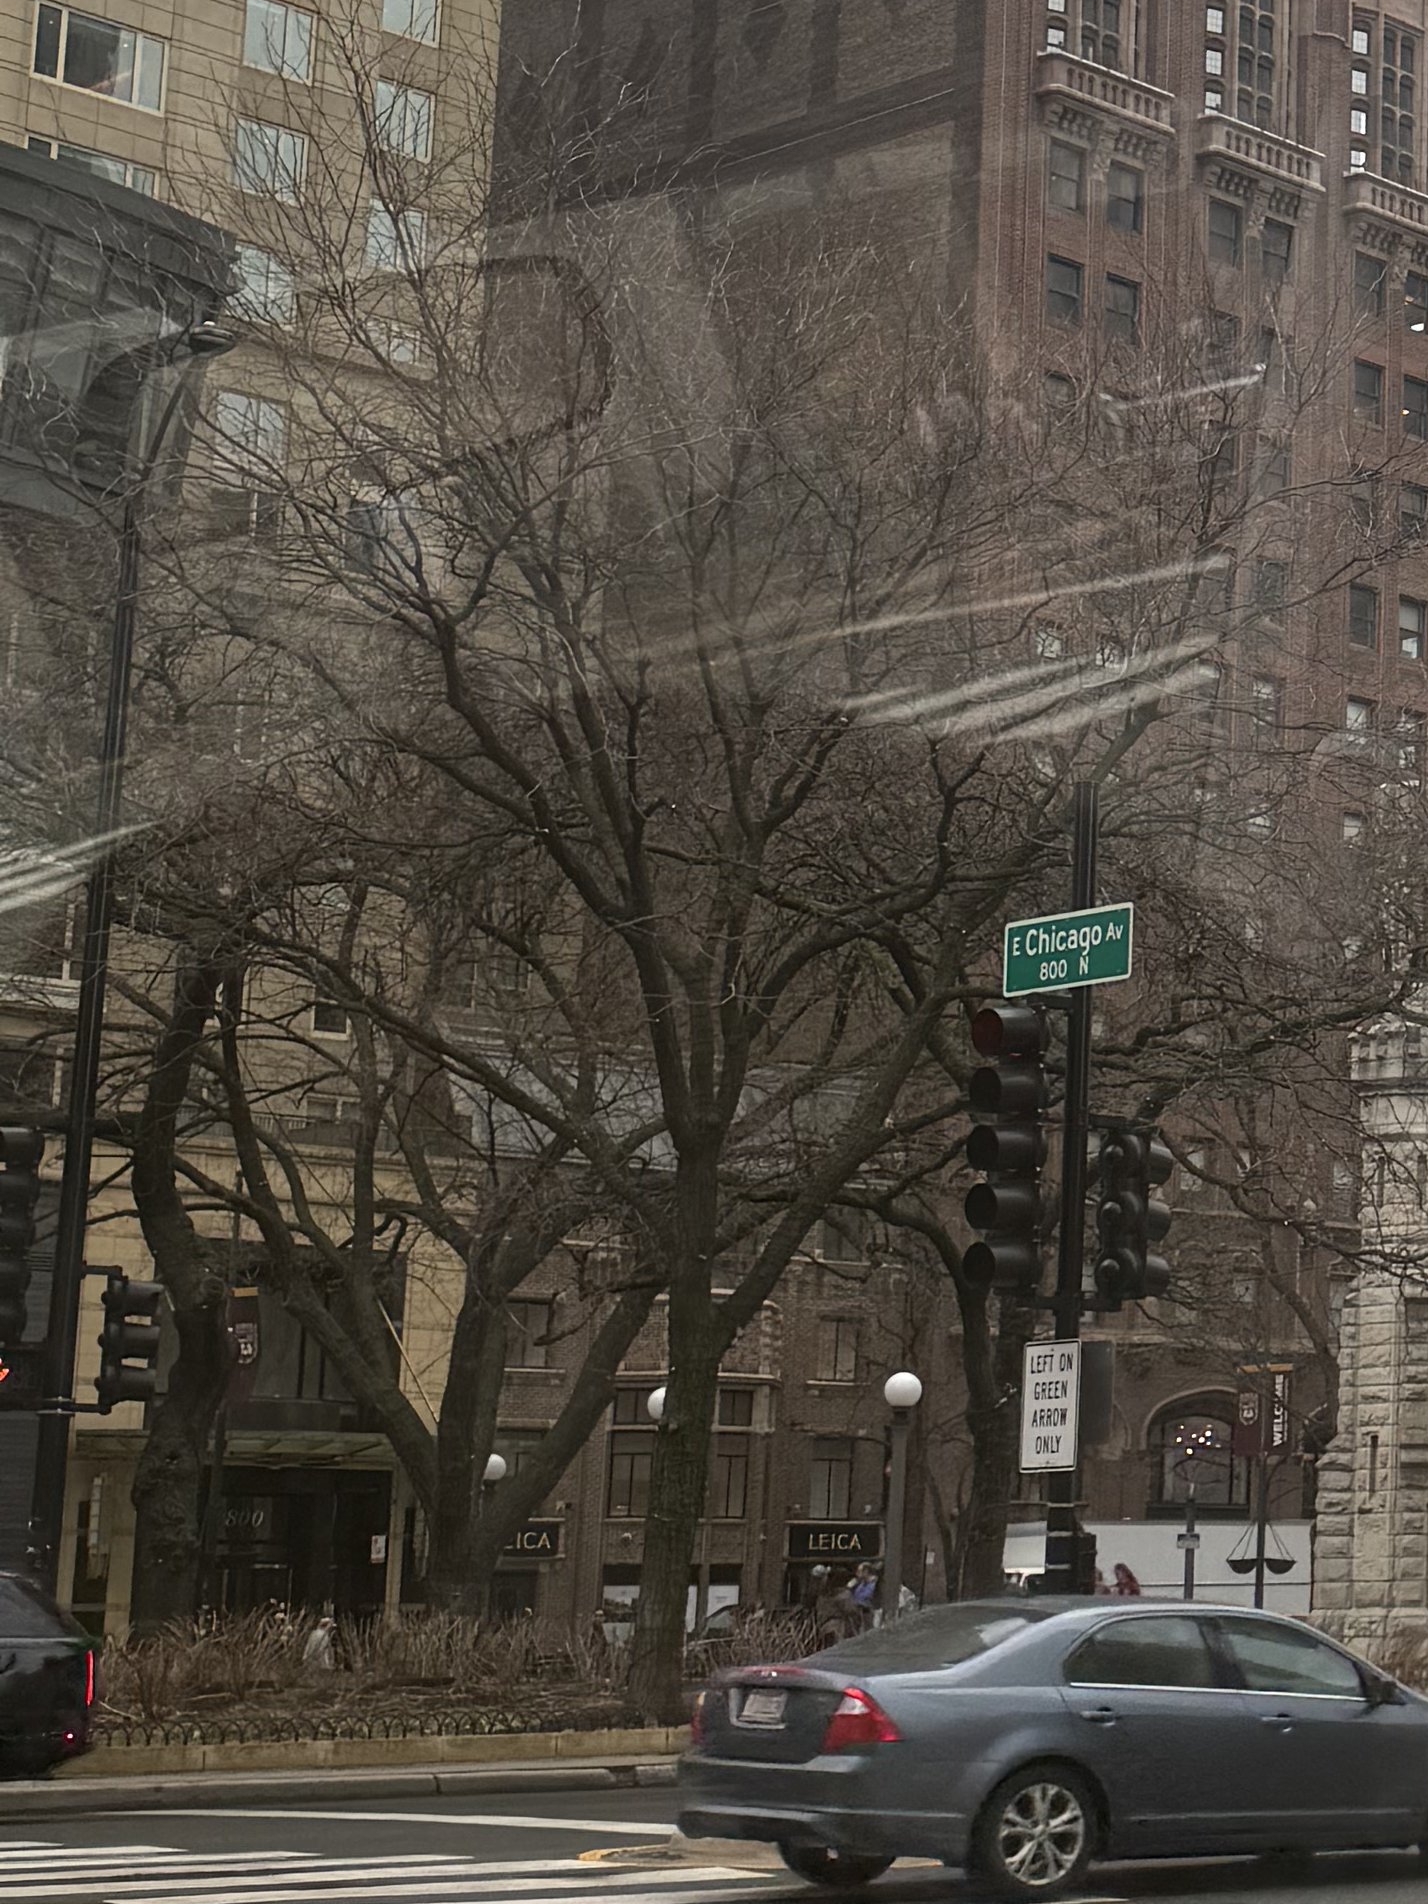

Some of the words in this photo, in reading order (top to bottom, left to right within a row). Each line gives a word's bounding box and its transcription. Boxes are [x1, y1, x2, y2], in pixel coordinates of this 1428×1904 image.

[1012, 937, 1021, 956] E
[1026, 925, 1102, 956] Chicago
[1105, 922, 1124, 941] Av
[1039, 959, 1067, 981] 800
[1079, 956, 1089, 975] N
[1030, 1354, 1054, 1375] LEFT
[1060, 1352, 1074, 1372] ON
[1034, 1380, 1068, 1400] GREEN
[1031, 1408, 1068, 1428] ARROW
[1035, 1435, 1062, 1454] ONLY
[808, 1533, 862, 1550] LEICA
